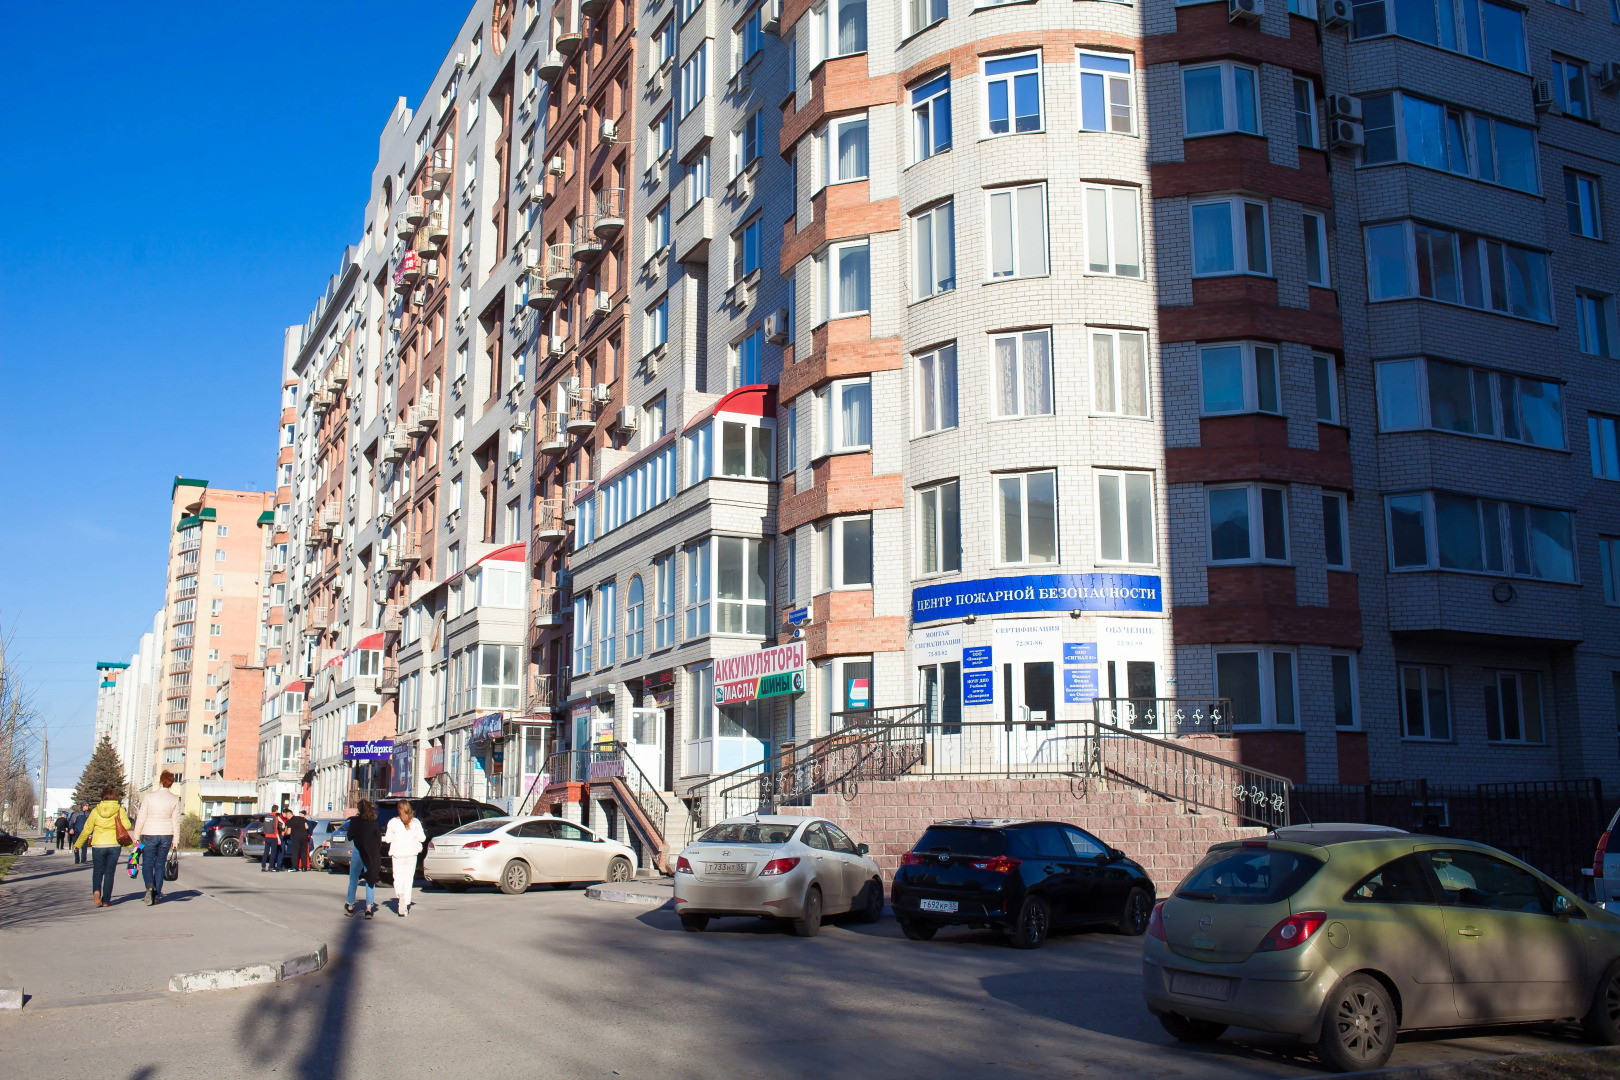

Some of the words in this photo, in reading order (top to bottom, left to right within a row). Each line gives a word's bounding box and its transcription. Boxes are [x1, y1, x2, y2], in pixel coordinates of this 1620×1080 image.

[917, 596, 952, 611] ЦЕНТР
[956, 586, 1035, 605] ПОЖАРНОЙ
[1039, 587, 1156, 600] БЕЗОПАСНОСТИ
[925, 630, 951, 638] МОНТАЖ
[995, 625, 1060, 634] СЕРТИФИКАЦИЯ
[1105, 626, 1155, 634] ОБУЧЕНИЕ
[915, 638, 961, 649] СИГНАЛИЗАЦИИ
[715, 644, 803, 682] АККУМУЛЯТОРЫ
[724, 682, 755, 701] МАСЛА
[761, 675, 790, 695] ШИНЫ
[349, 744, 393, 757] ТракМарке
